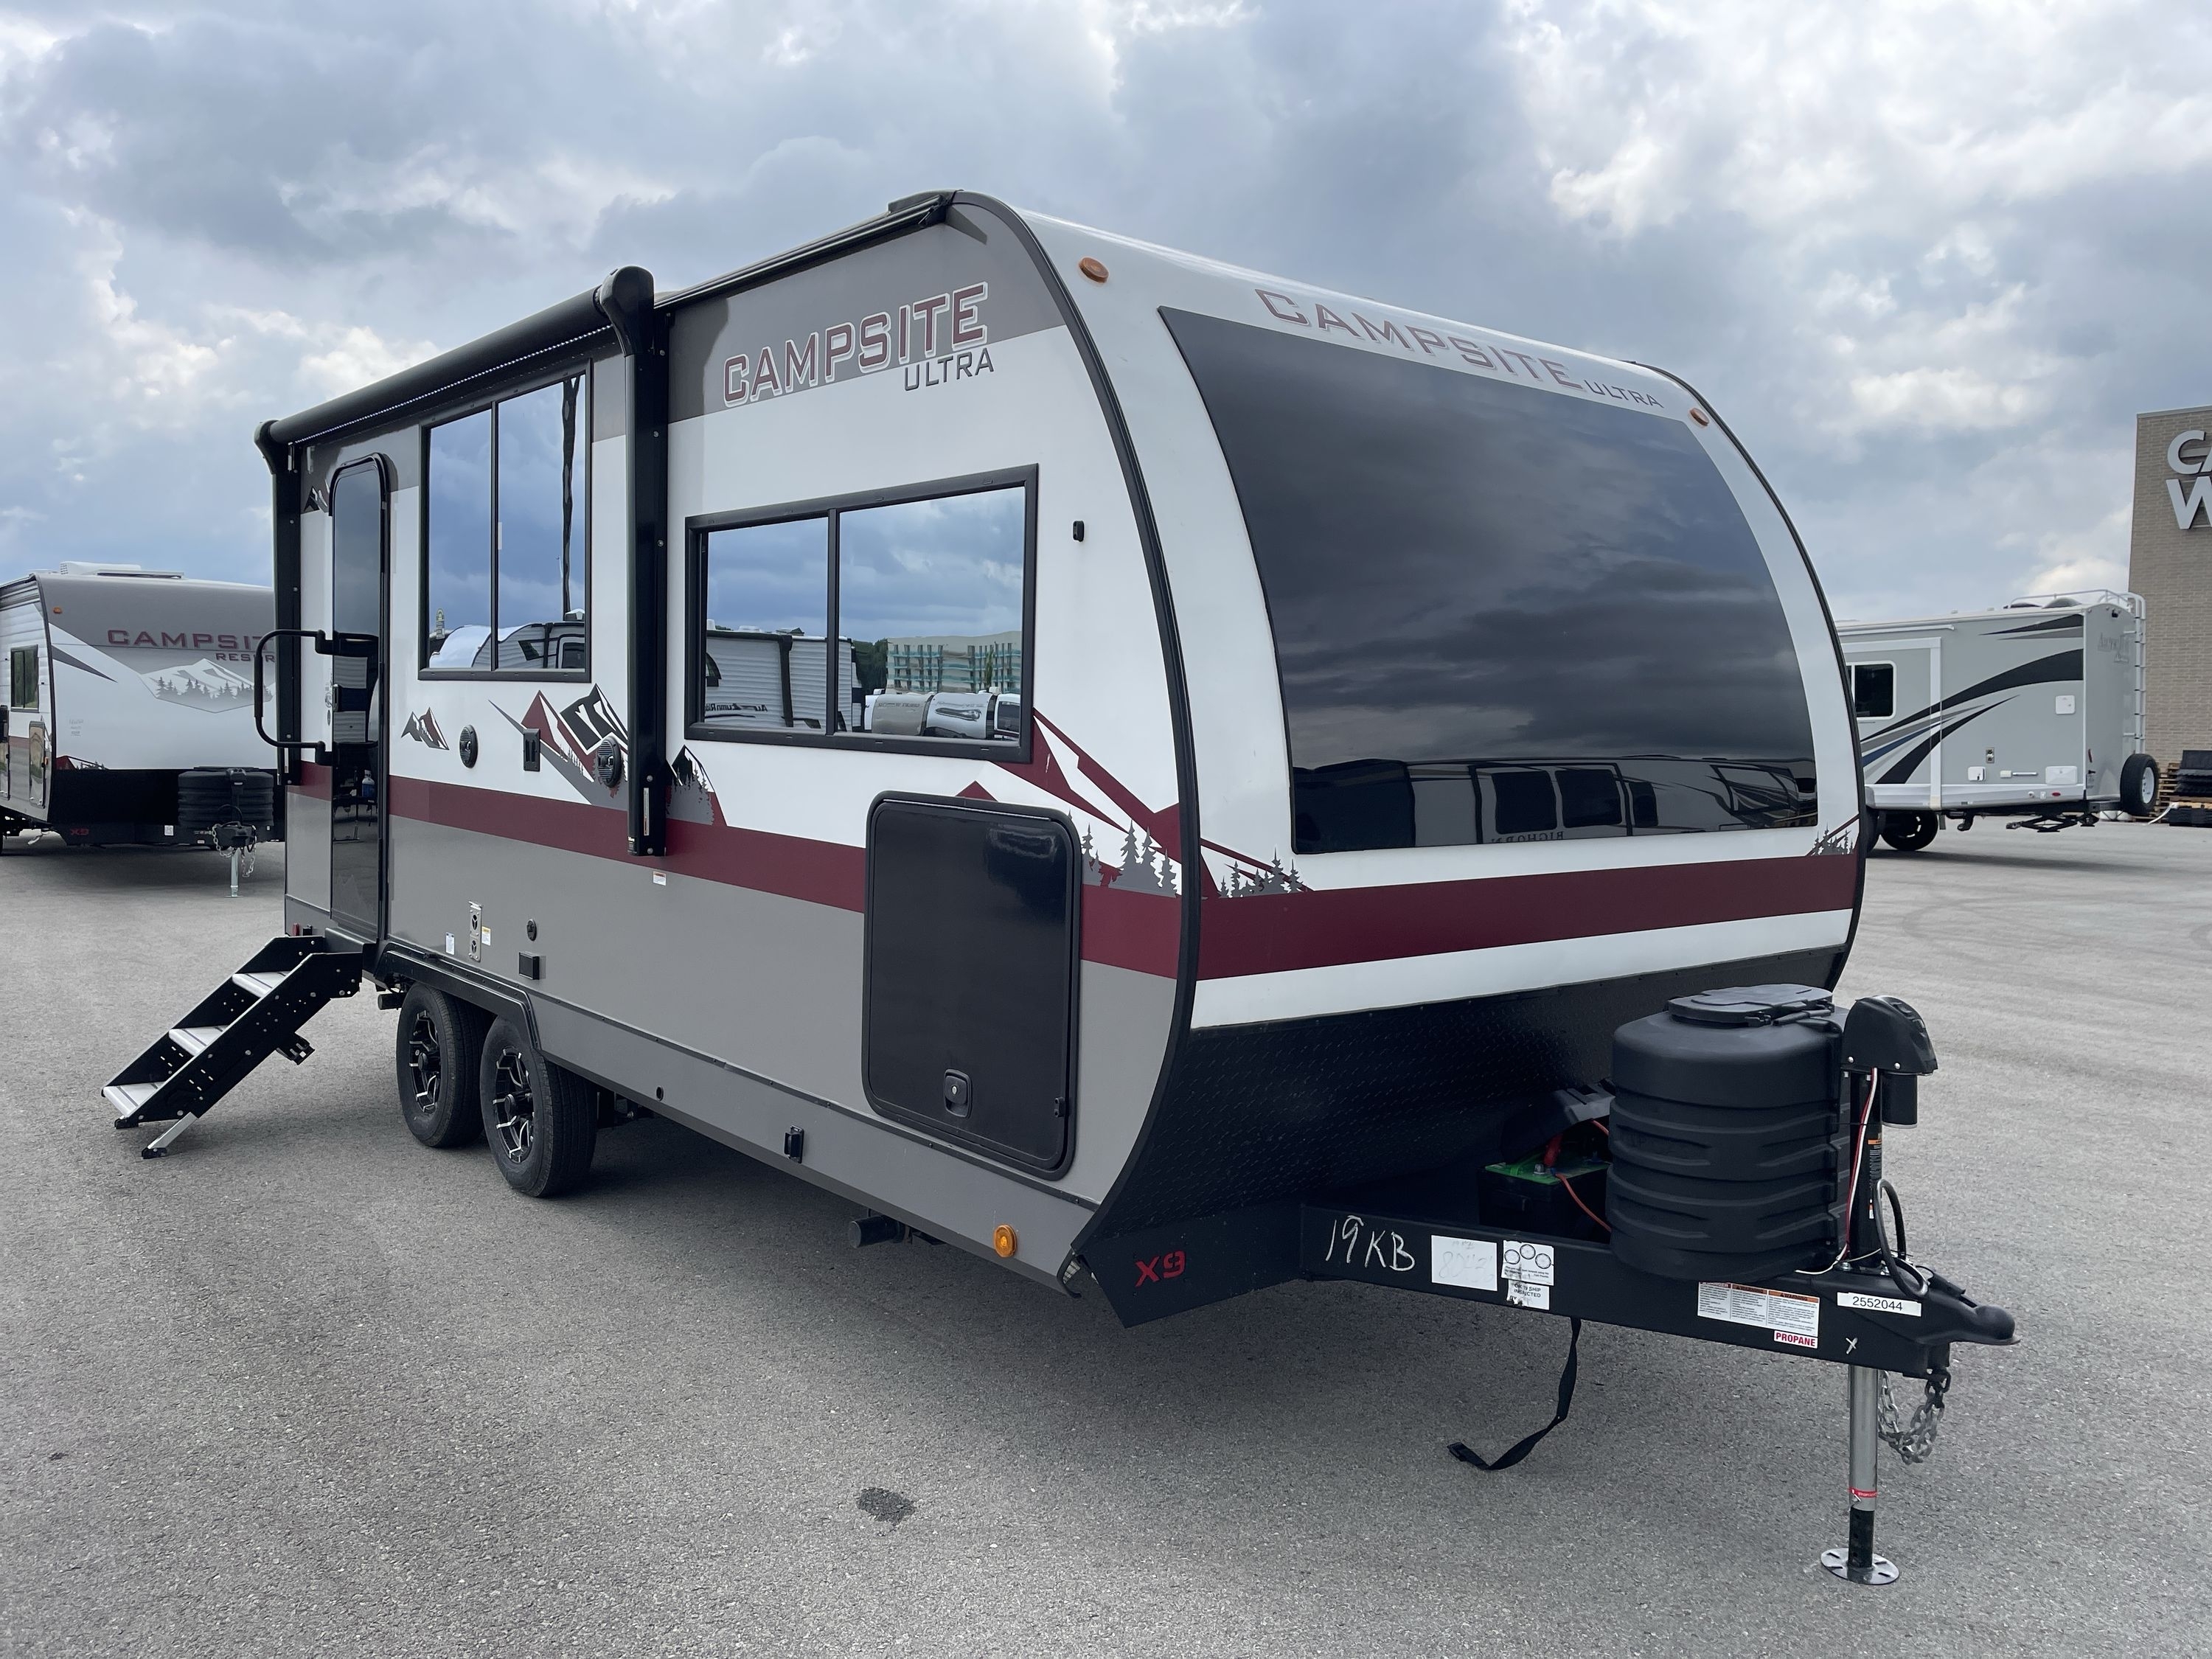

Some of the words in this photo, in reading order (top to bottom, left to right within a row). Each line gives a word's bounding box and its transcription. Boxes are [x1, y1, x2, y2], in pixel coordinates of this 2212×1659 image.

[723, 281, 989, 408] CAMPSITE
[1255, 288, 1585, 391] CAMPSITE
[1584, 380, 1664, 408] ULTRA
[903, 347, 995, 392] ULTRA
[1134, 1251, 1186, 1287] X9
[1852, 1295, 1903, 1311] 2552044
[1775, 1332, 1815, 1347] PROPANE
